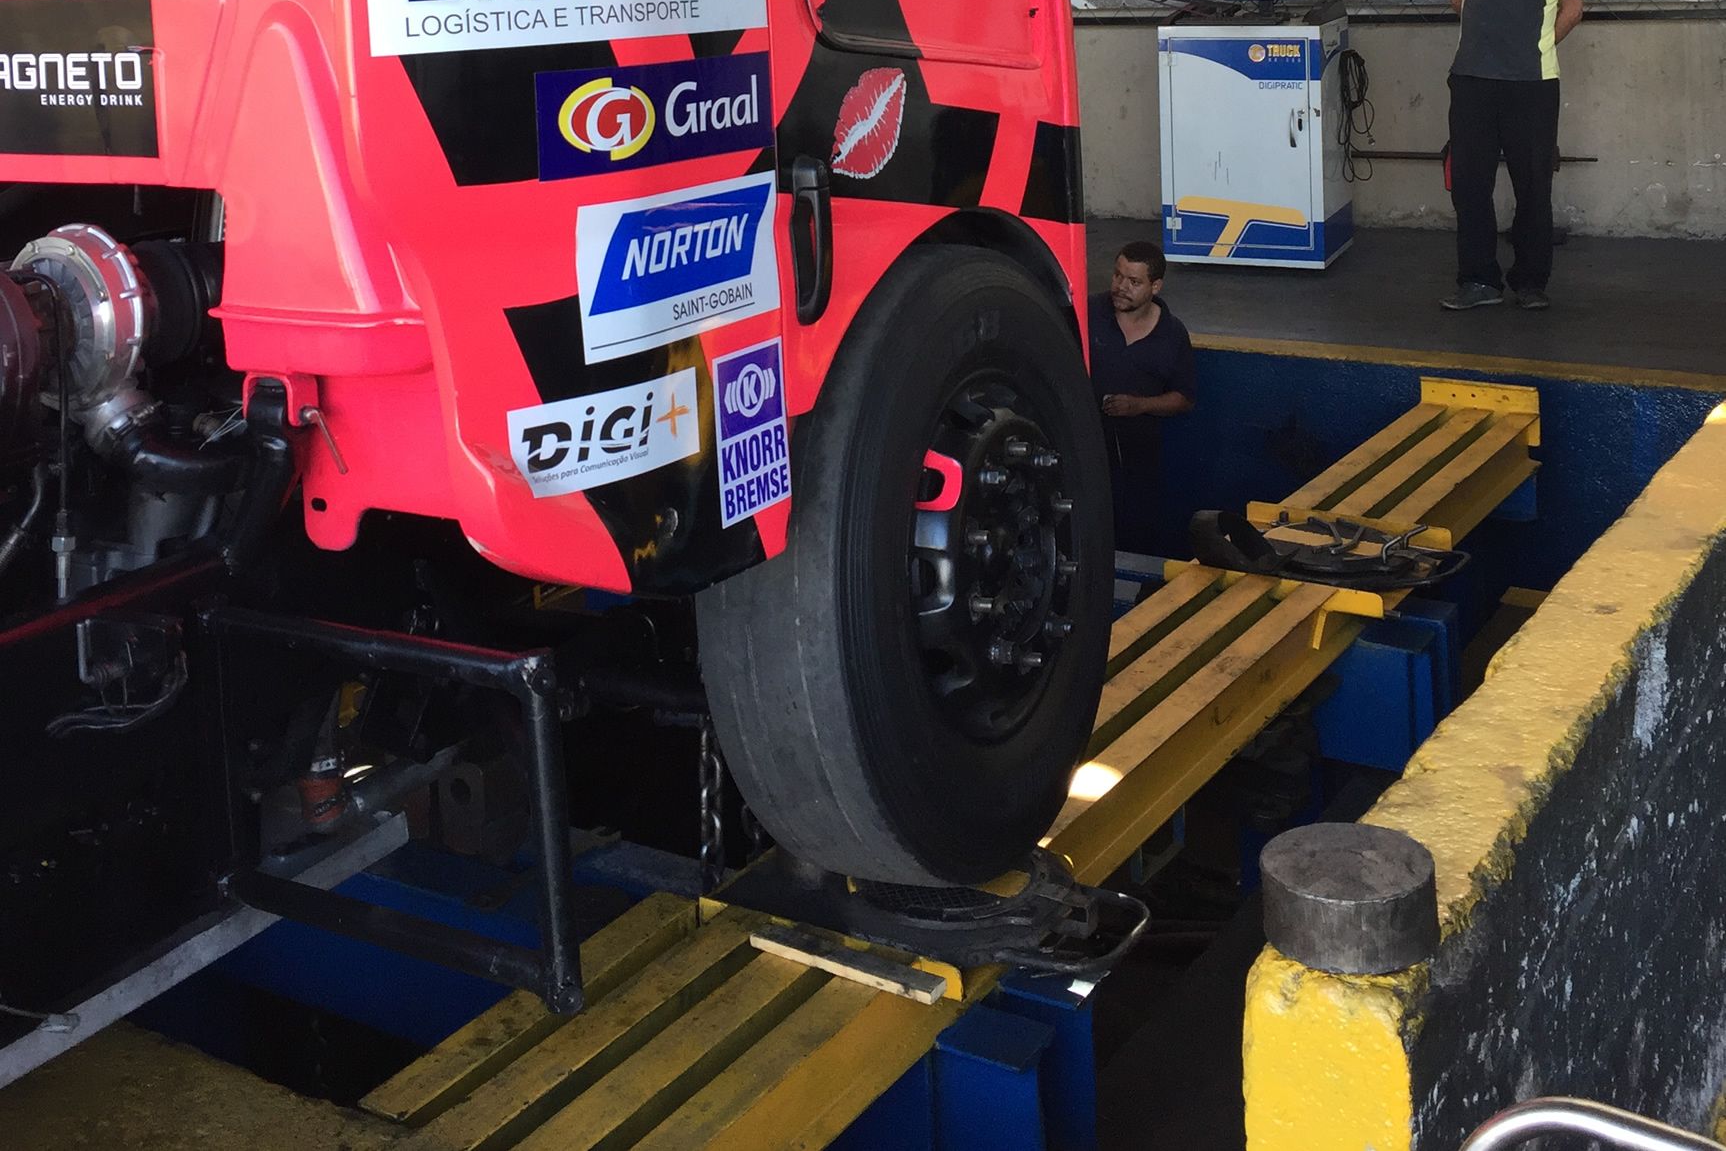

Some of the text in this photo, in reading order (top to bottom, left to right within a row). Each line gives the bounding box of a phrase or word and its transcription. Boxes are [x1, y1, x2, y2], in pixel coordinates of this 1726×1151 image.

[404, 0, 700, 38] LOGÍSTICA E TRANSPORTE
[1267, 44, 1301, 58] TRUCK
[40, 93, 143, 106] ENERGY DRINK
[1258, 81, 1303, 90] DIGIPRATIC
[665, 74, 759, 137] Graal
[621, 212, 749, 281] NORTON
[672, 282, 754, 321] SAINT-GOBAIN
[721, 423, 787, 485] KNORR
[560, 466, 579, 481] para
[724, 463, 790, 522] BREMSE
